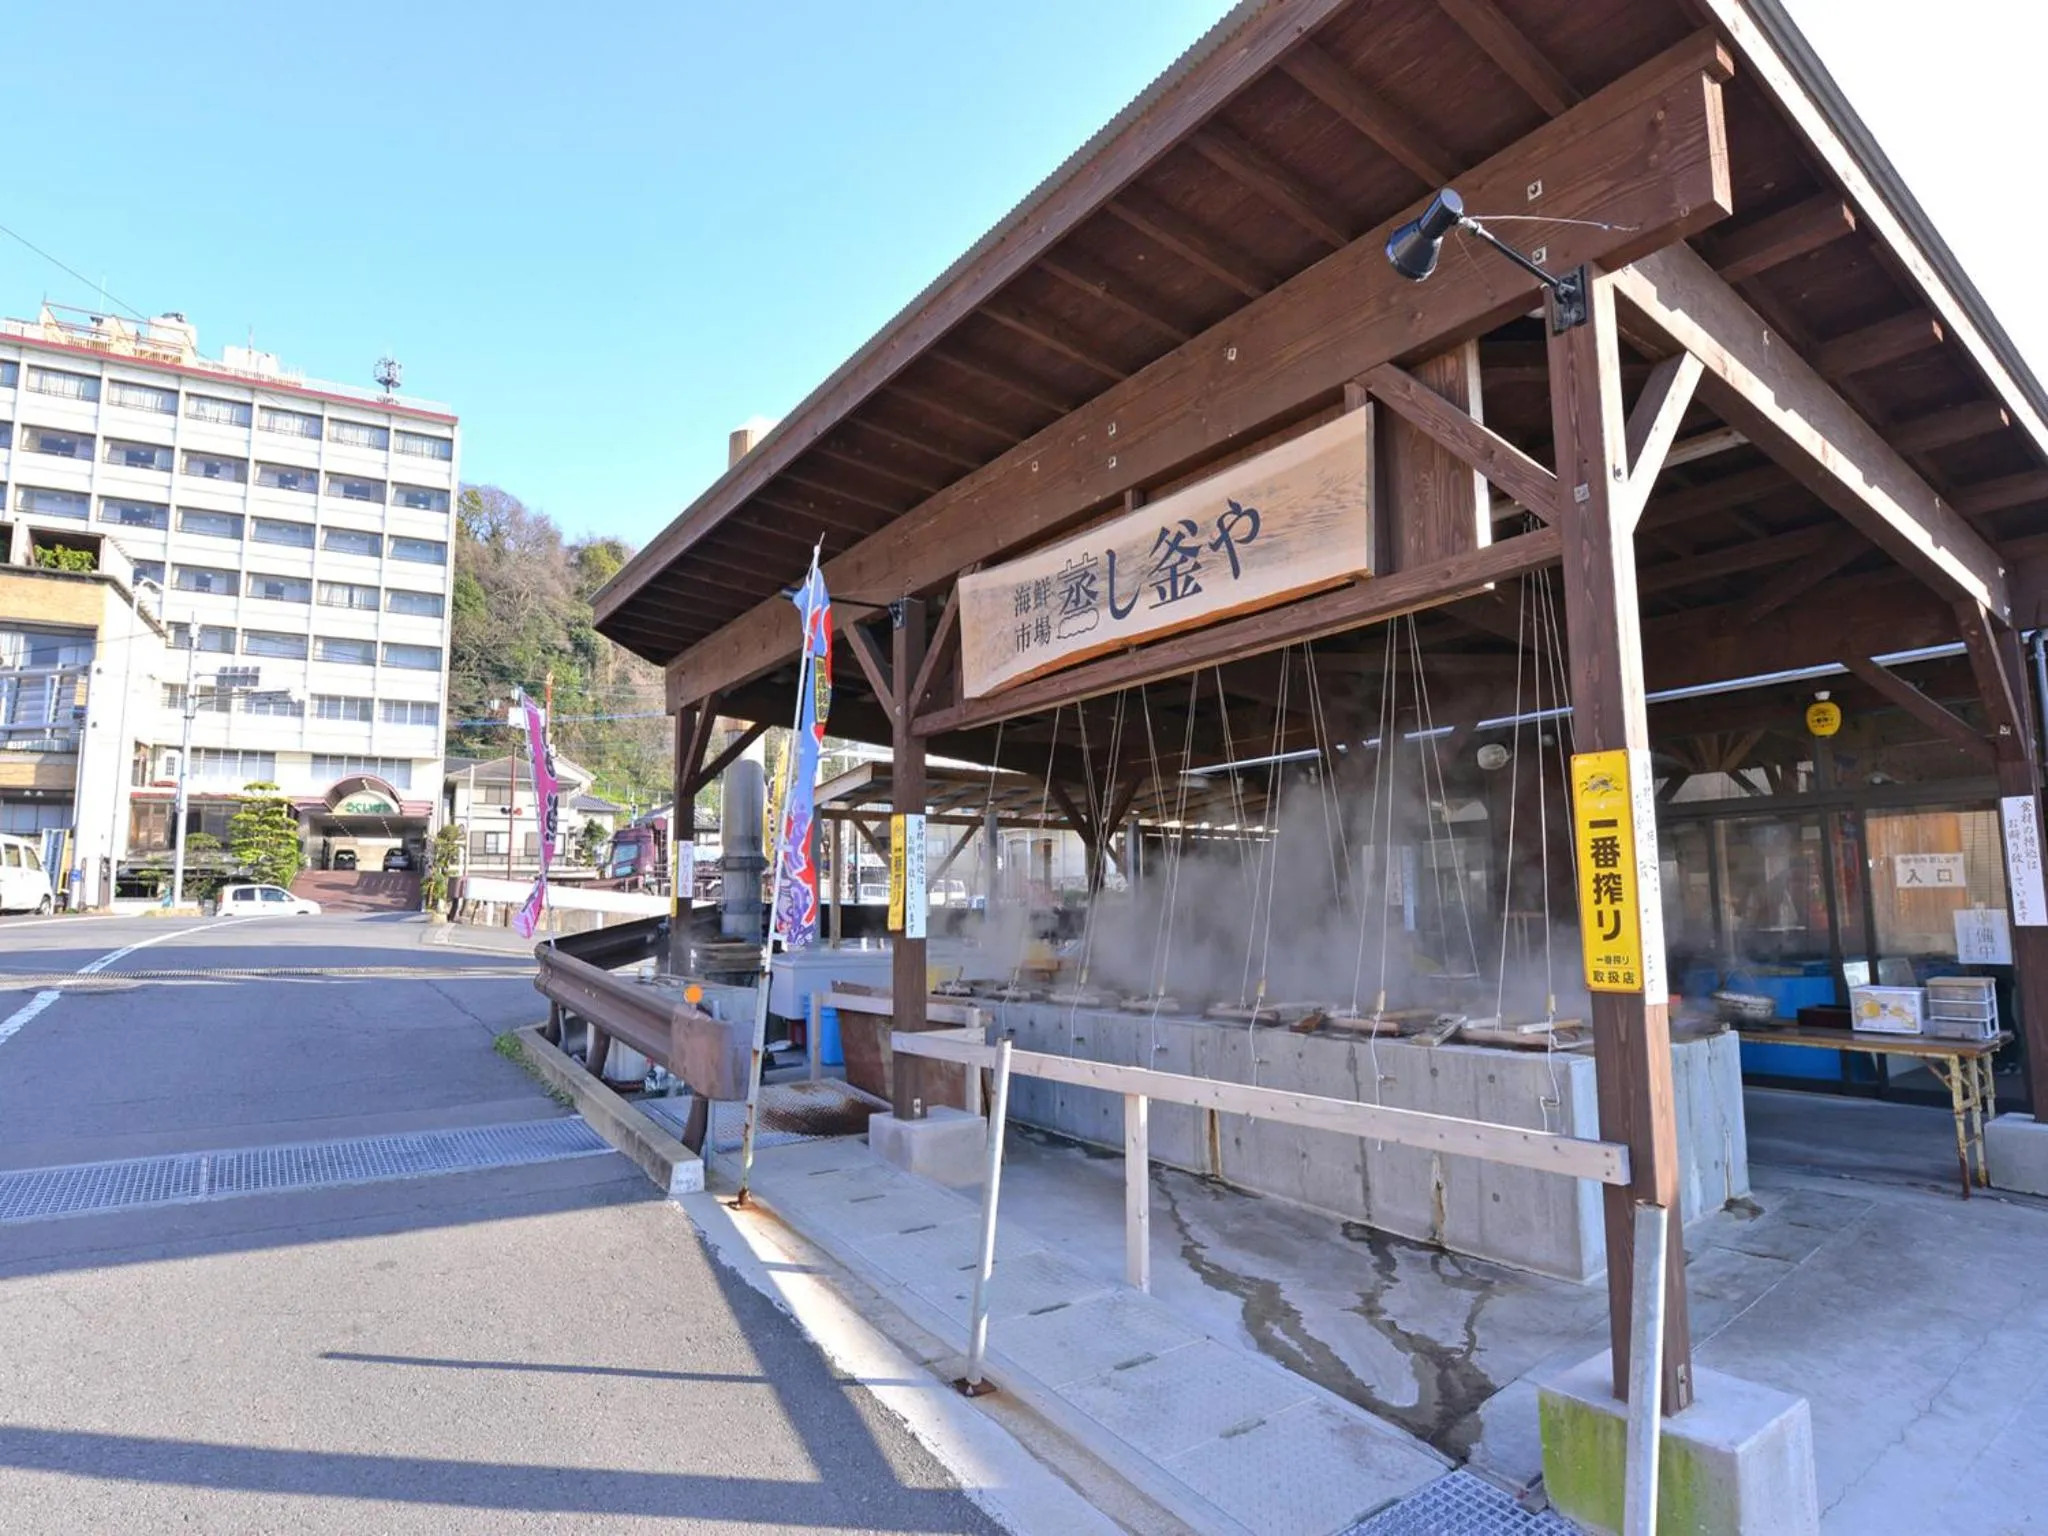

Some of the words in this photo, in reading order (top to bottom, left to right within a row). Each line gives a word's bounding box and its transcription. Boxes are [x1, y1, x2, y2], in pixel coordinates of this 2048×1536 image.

[1056, 497, 1261, 640] 蒸し釜や
[1014, 575, 1052, 618] 海鮮
[1014, 615, 1052, 653] 市場
[1589, 818, 1624, 941] 一番搾り
[1906, 868, 1953, 884] 入口
[1592, 970, 1635, 984] 取扱店
